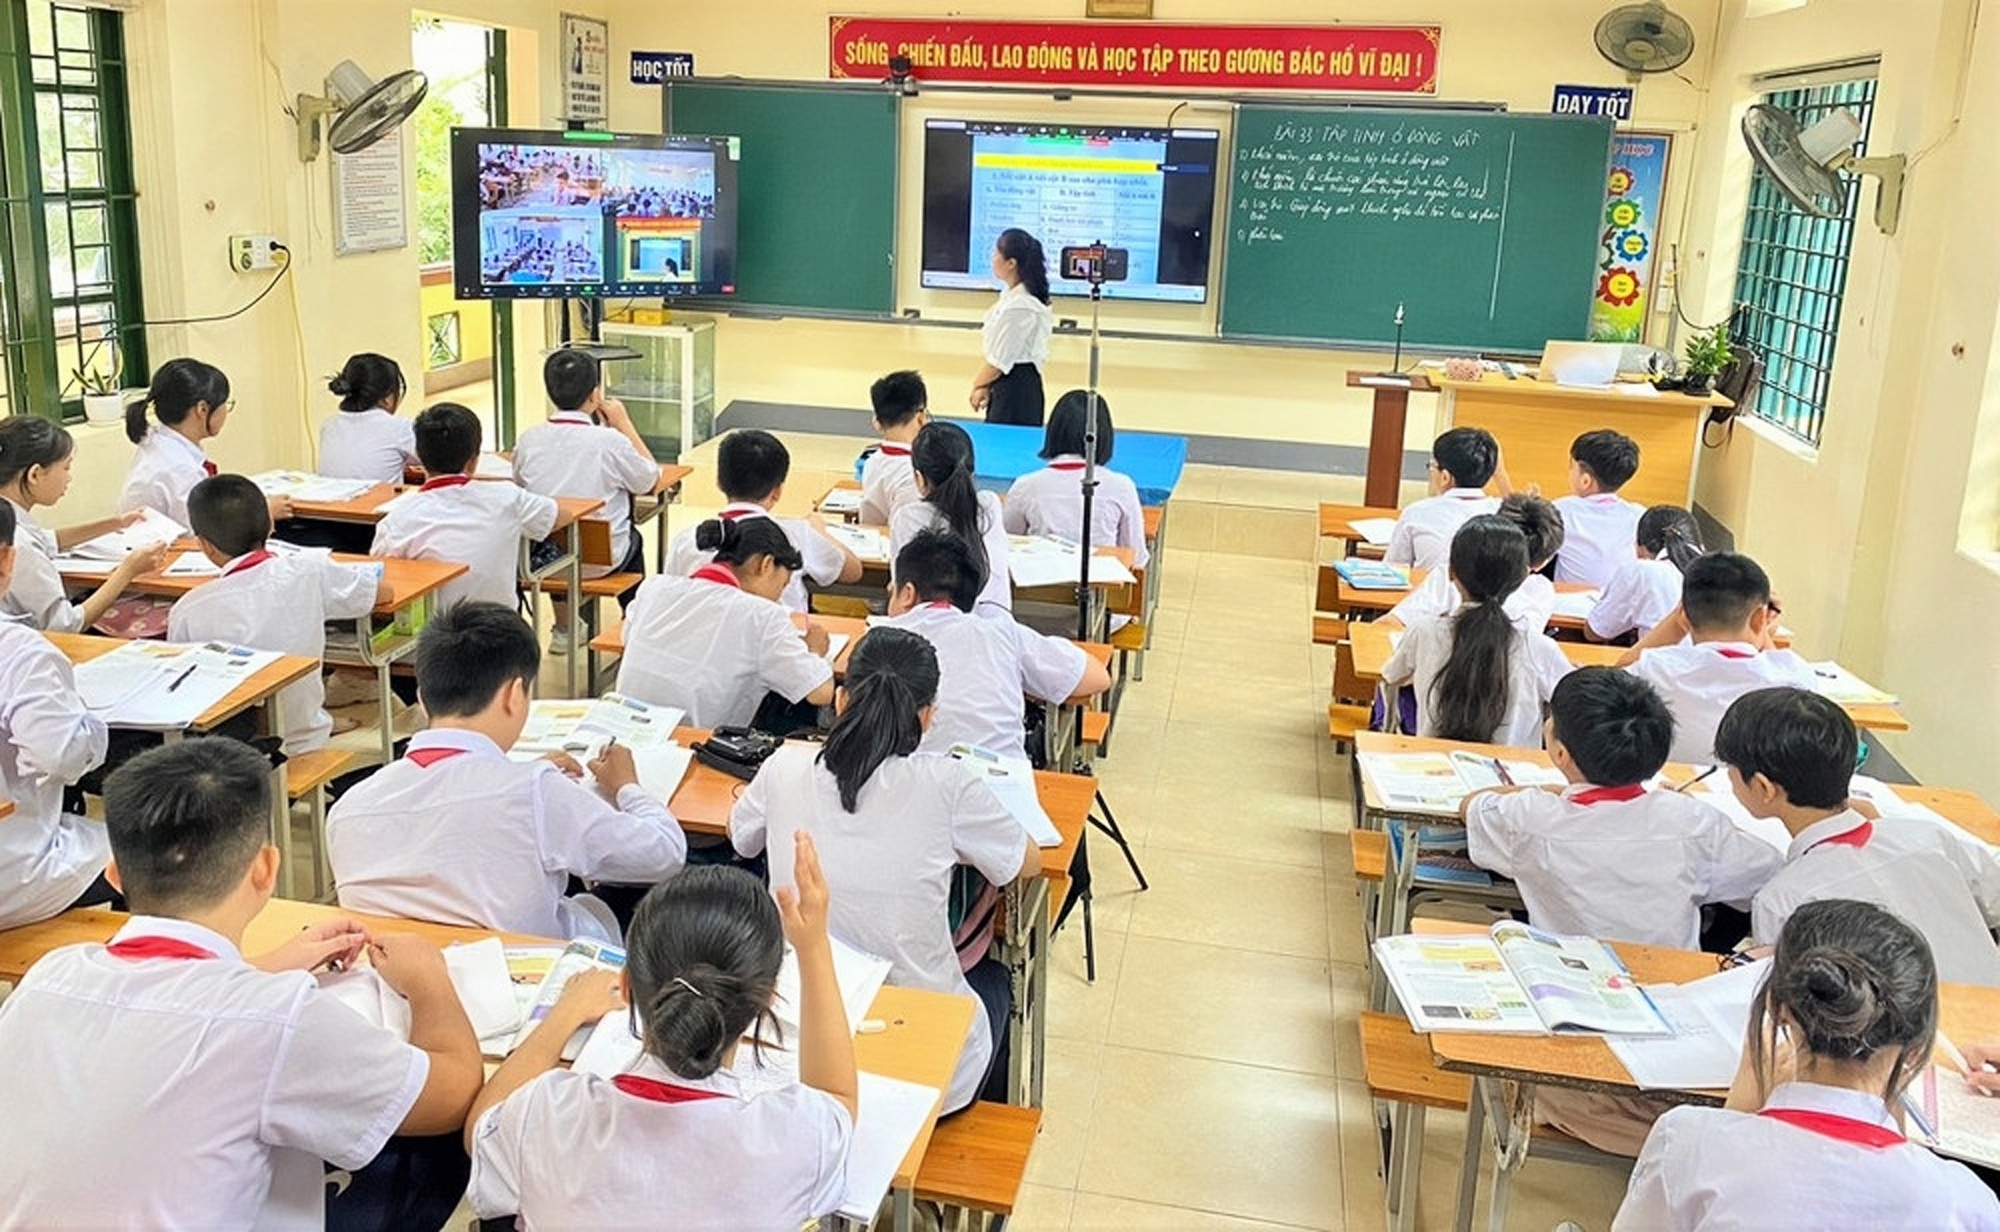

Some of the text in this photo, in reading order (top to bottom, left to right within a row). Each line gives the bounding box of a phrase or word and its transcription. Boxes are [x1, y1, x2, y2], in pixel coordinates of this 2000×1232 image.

[633, 56, 690, 82] HỌC TỐT
[951, 35, 987, 70] ĐẤU,
[992, 45, 1023, 68] LAO
[1027, 41, 1073, 74] ĐỘNG
[1077, 41, 1098, 71] VÀ
[1103, 47, 1137, 76] HỌC
[1142, 43, 1173, 77] TẬP
[1178, 49, 1220, 73] THEO
[1225, 47, 1284, 74] GƯƠNG
[1289, 45, 1325, 75] BÁC
[1359, 47, 1377, 76] VĨ
[1379, 52, 1410, 82] ĐẠI
[1597, 91, 1629, 117] TỐT
